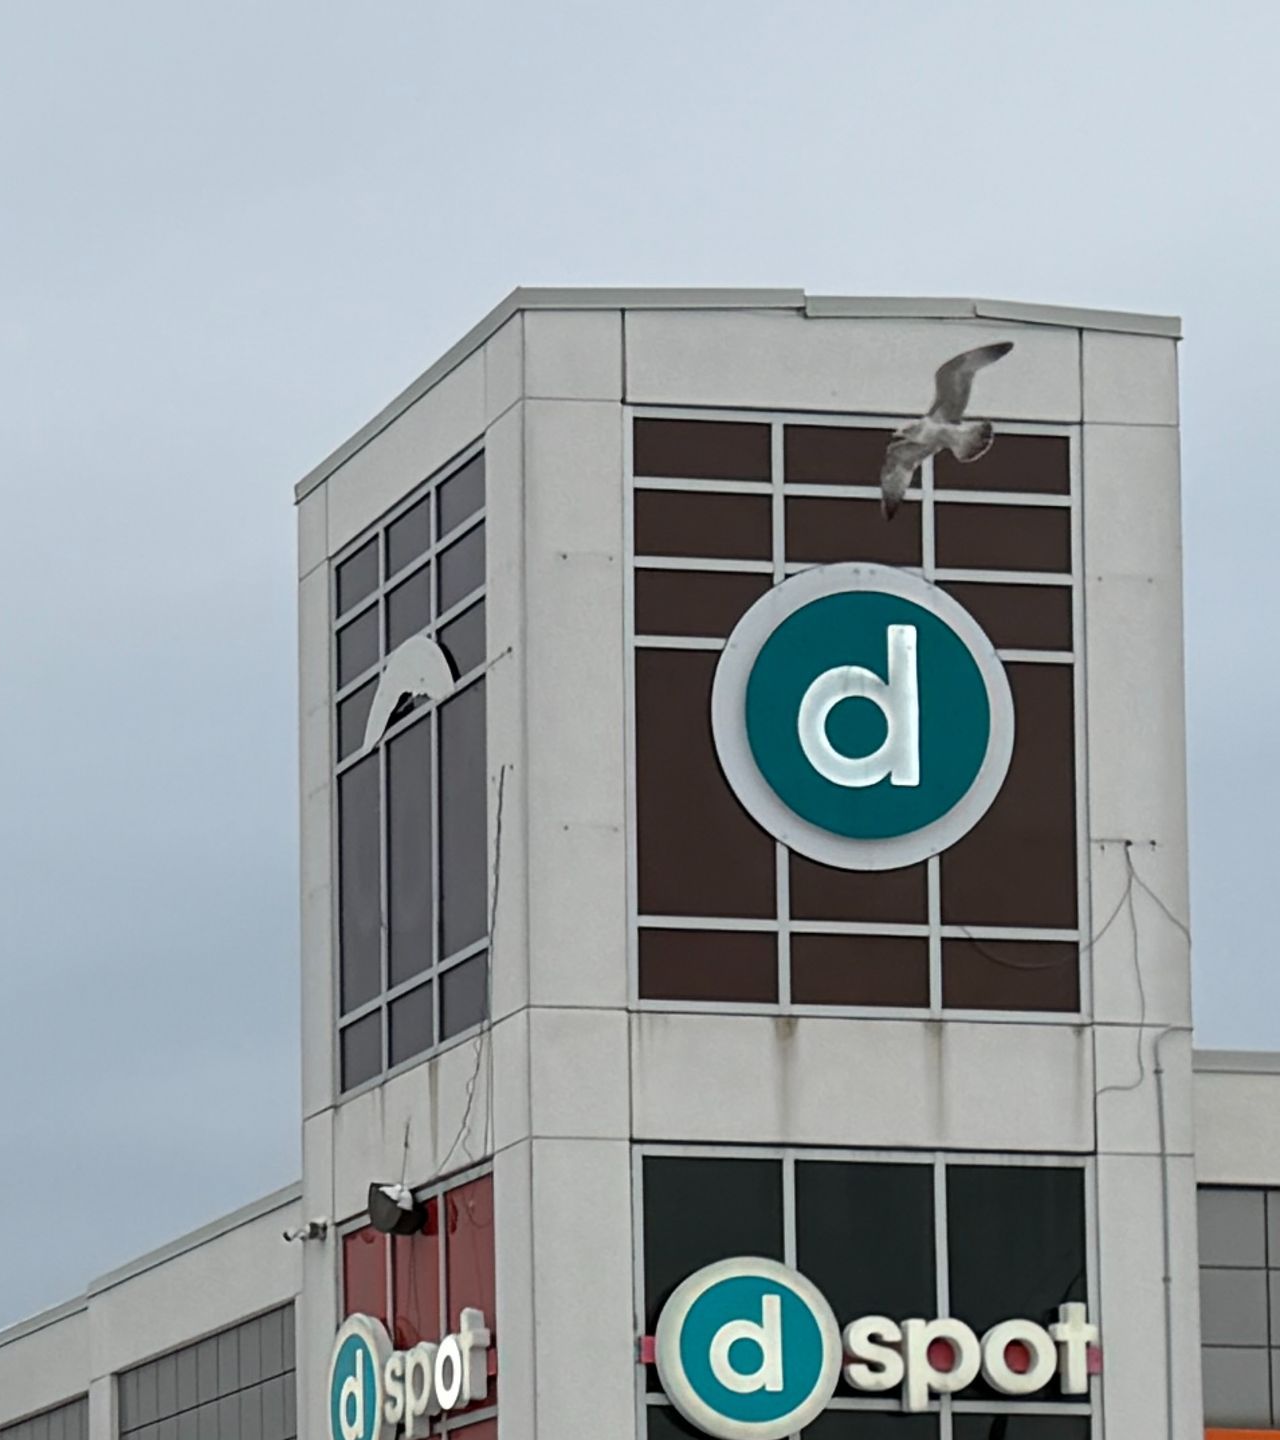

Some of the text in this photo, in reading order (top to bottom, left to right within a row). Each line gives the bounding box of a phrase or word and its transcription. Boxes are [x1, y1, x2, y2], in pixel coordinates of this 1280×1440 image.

[798, 625, 920, 787] d
[384, 1308, 491, 1439] spot
[709, 1294, 1098, 1412] d spot
